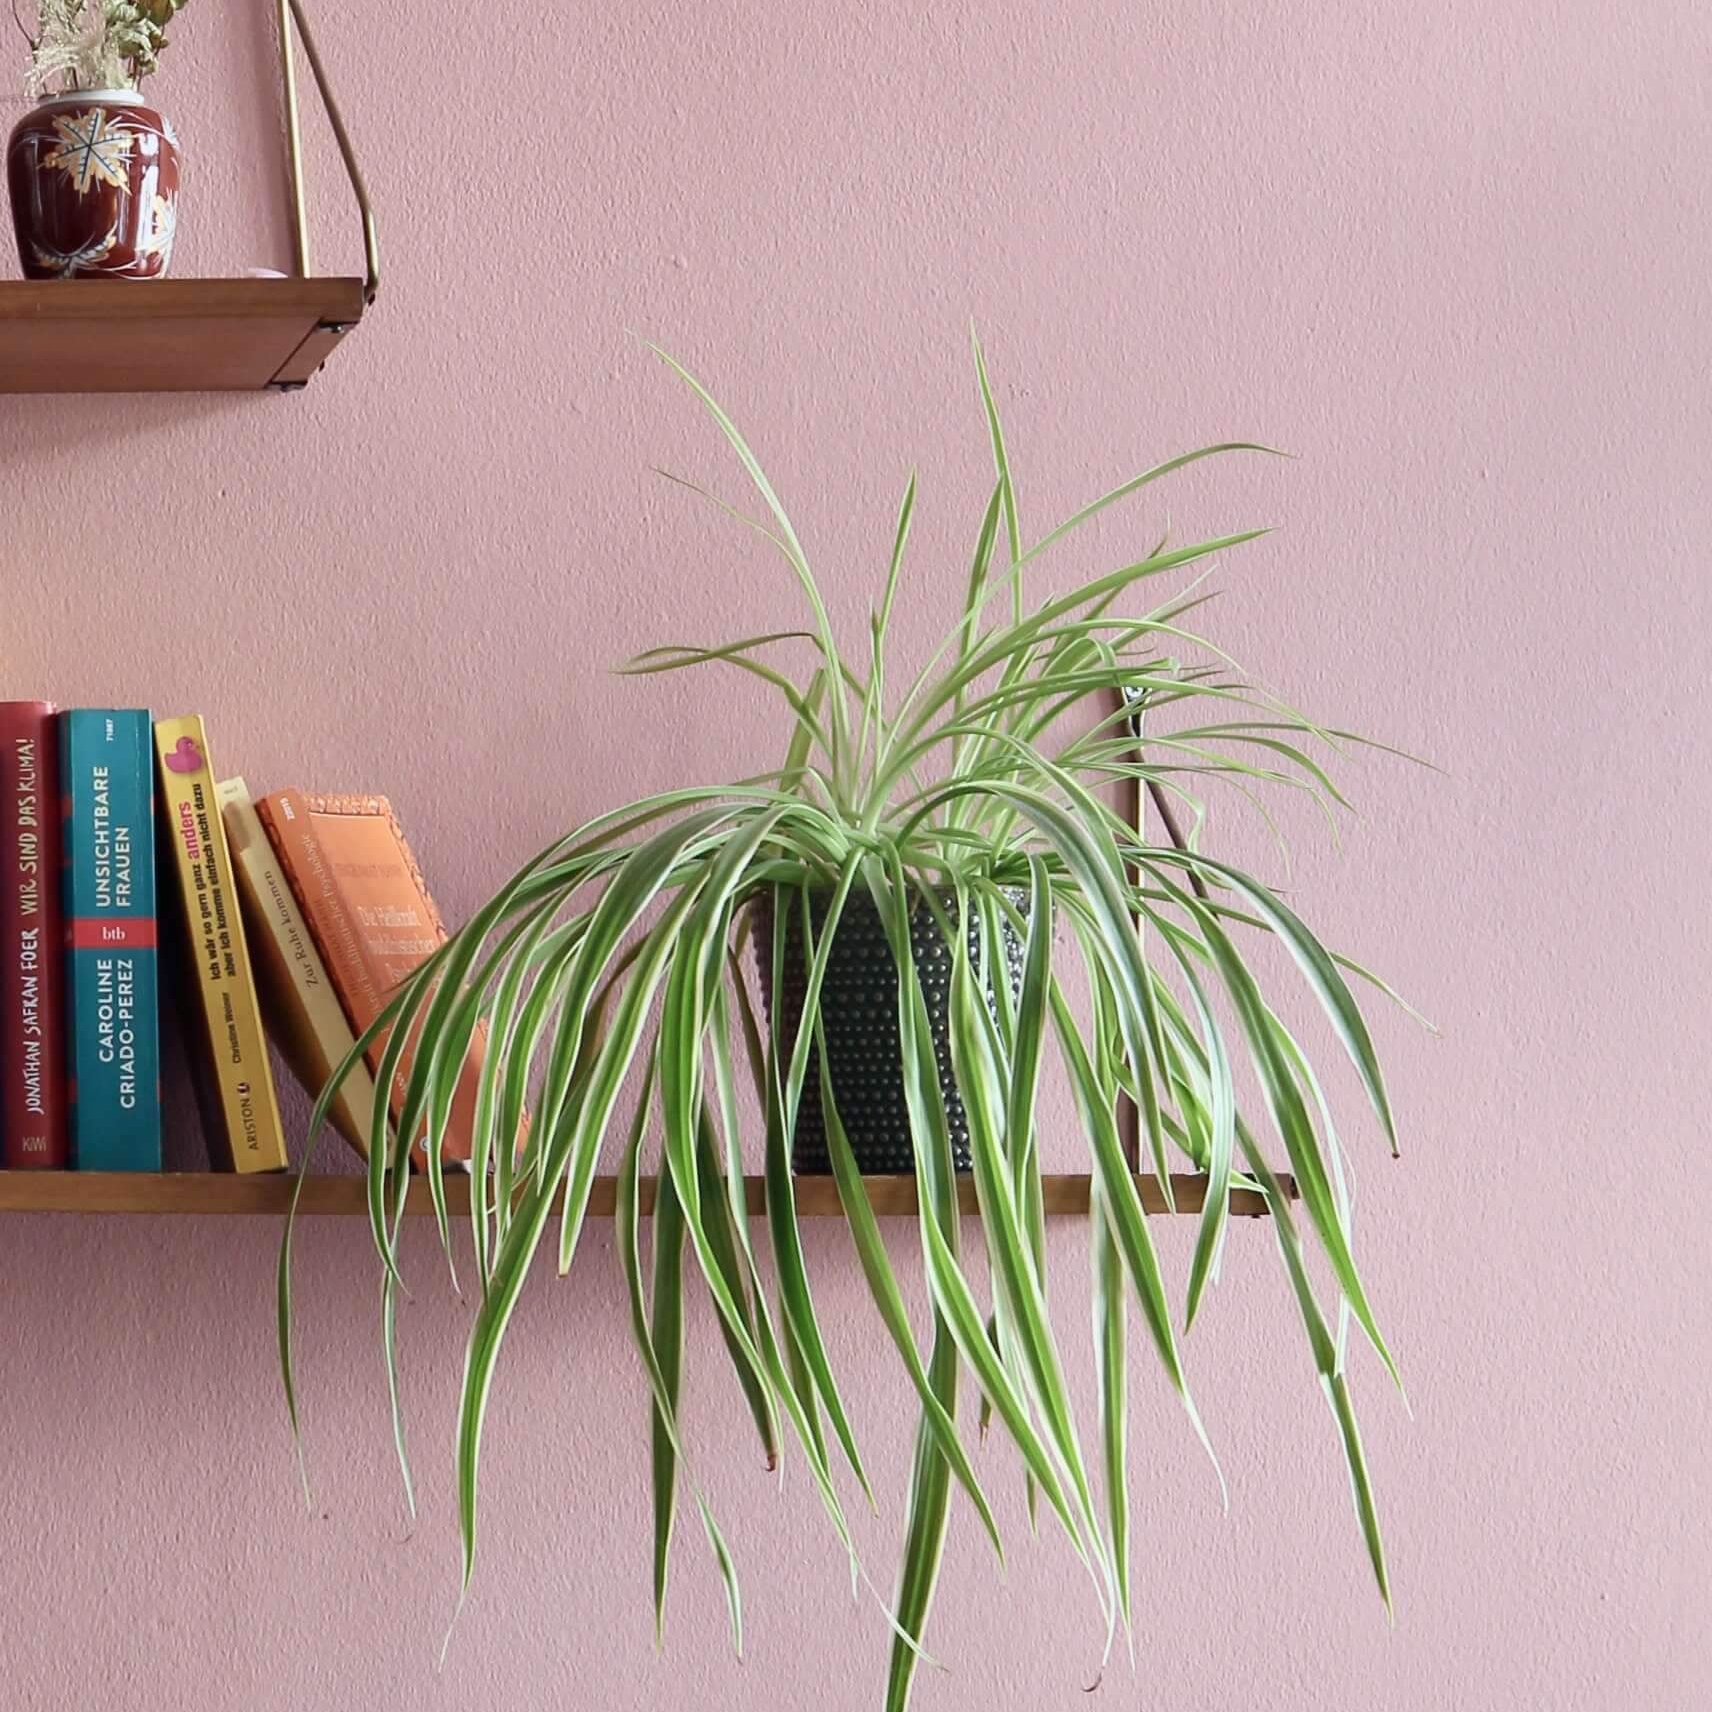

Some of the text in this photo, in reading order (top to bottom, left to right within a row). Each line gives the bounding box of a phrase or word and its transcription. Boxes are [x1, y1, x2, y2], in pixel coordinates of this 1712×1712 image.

[94, 766, 110, 907] UNSICHTBARE
[116, 827, 132, 907] FRAUEN
[179, 801, 221, 980] Ich wär so gern ganz anders
[192, 782, 236, 977] aber ich komme einfach nicht dazu
[16, 738, 43, 1114] JONATHAN SAFRAN FOER WIR SIND DAS KLIMA!
[102, 926, 126, 940] btb
[264, 871, 319, 989] Zur Ruhe kommen
[98, 958, 113, 1064] CAROLINE
[118, 958, 135, 1110] CRIADO-PEREZ
[229, 1024, 242, 1064] Christine
[238, 1098, 259, 1152] ARISTON
